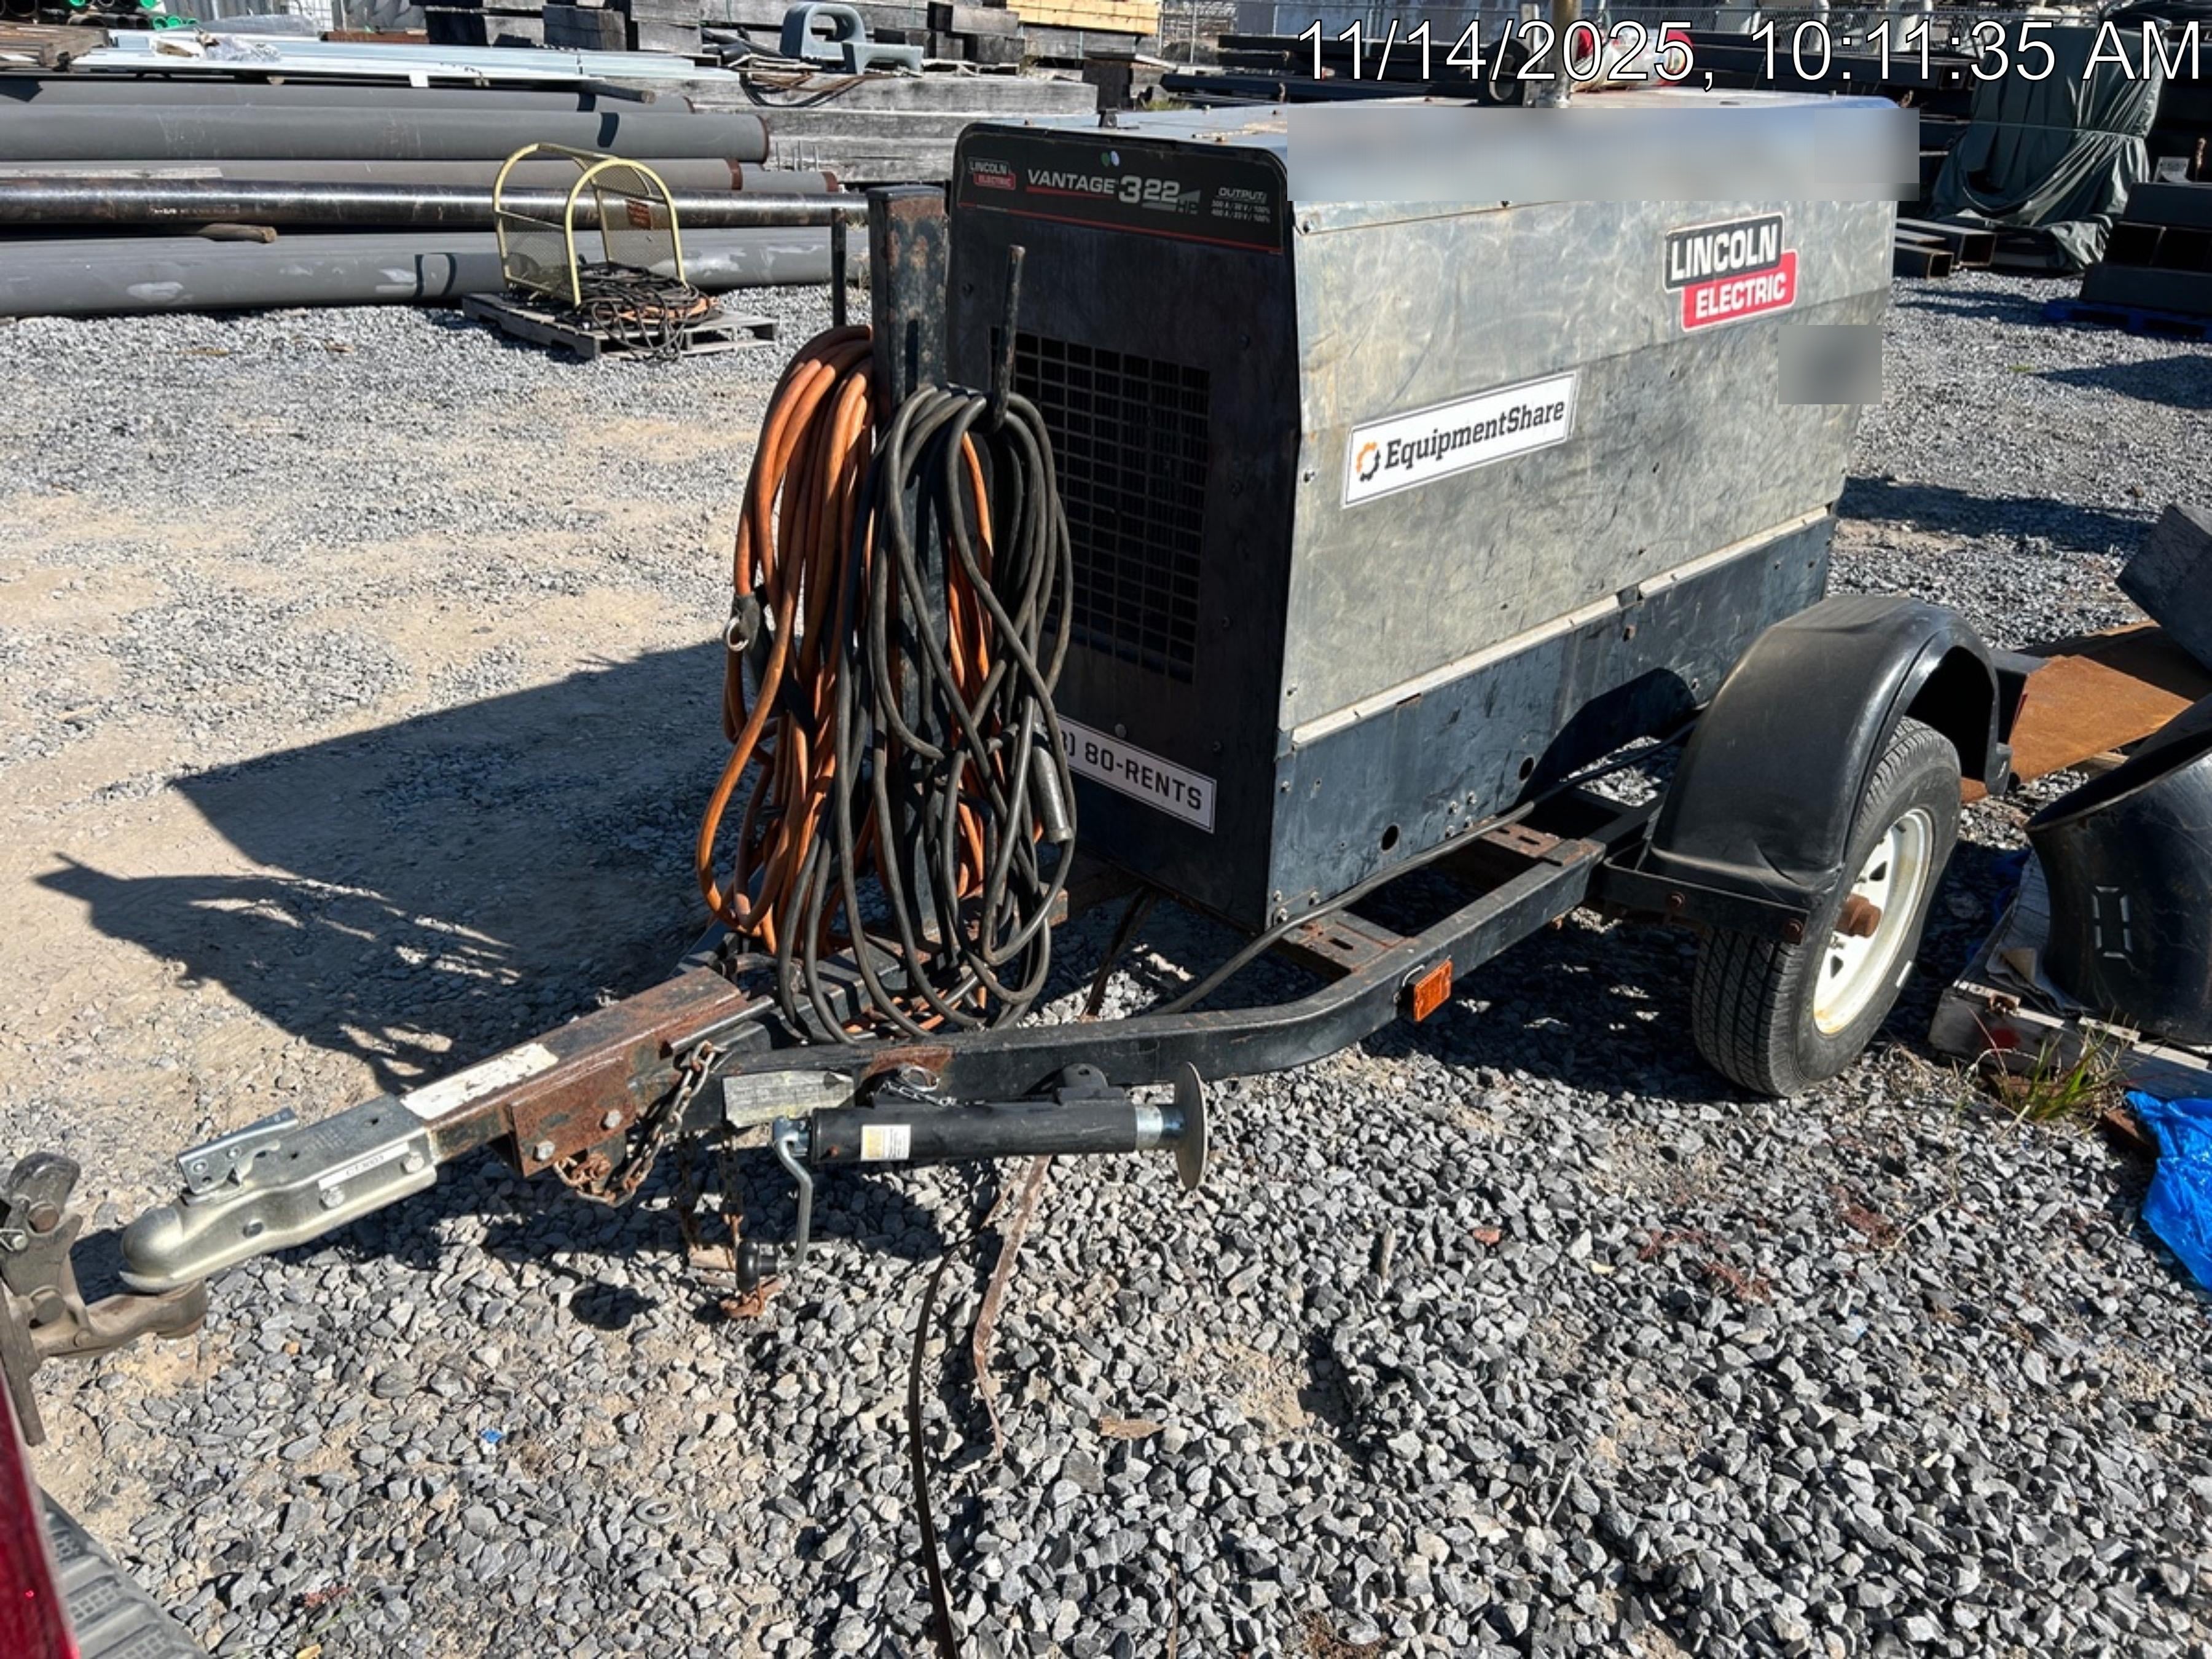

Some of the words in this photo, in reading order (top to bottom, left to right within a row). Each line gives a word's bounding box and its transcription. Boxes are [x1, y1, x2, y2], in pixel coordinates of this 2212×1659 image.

[969, 162, 1008, 175] LINCOLN
[1027, 169, 1116, 194] VANTAGE
[1118, 175, 1180, 204] 322
[1671, 223, 1778, 281] LINCOLN
[1695, 272, 1786, 320] ELECTRIC
[1384, 401, 1565, 471] EquipmentShare
[1084, 742, 1202, 810] 80-RENTS
